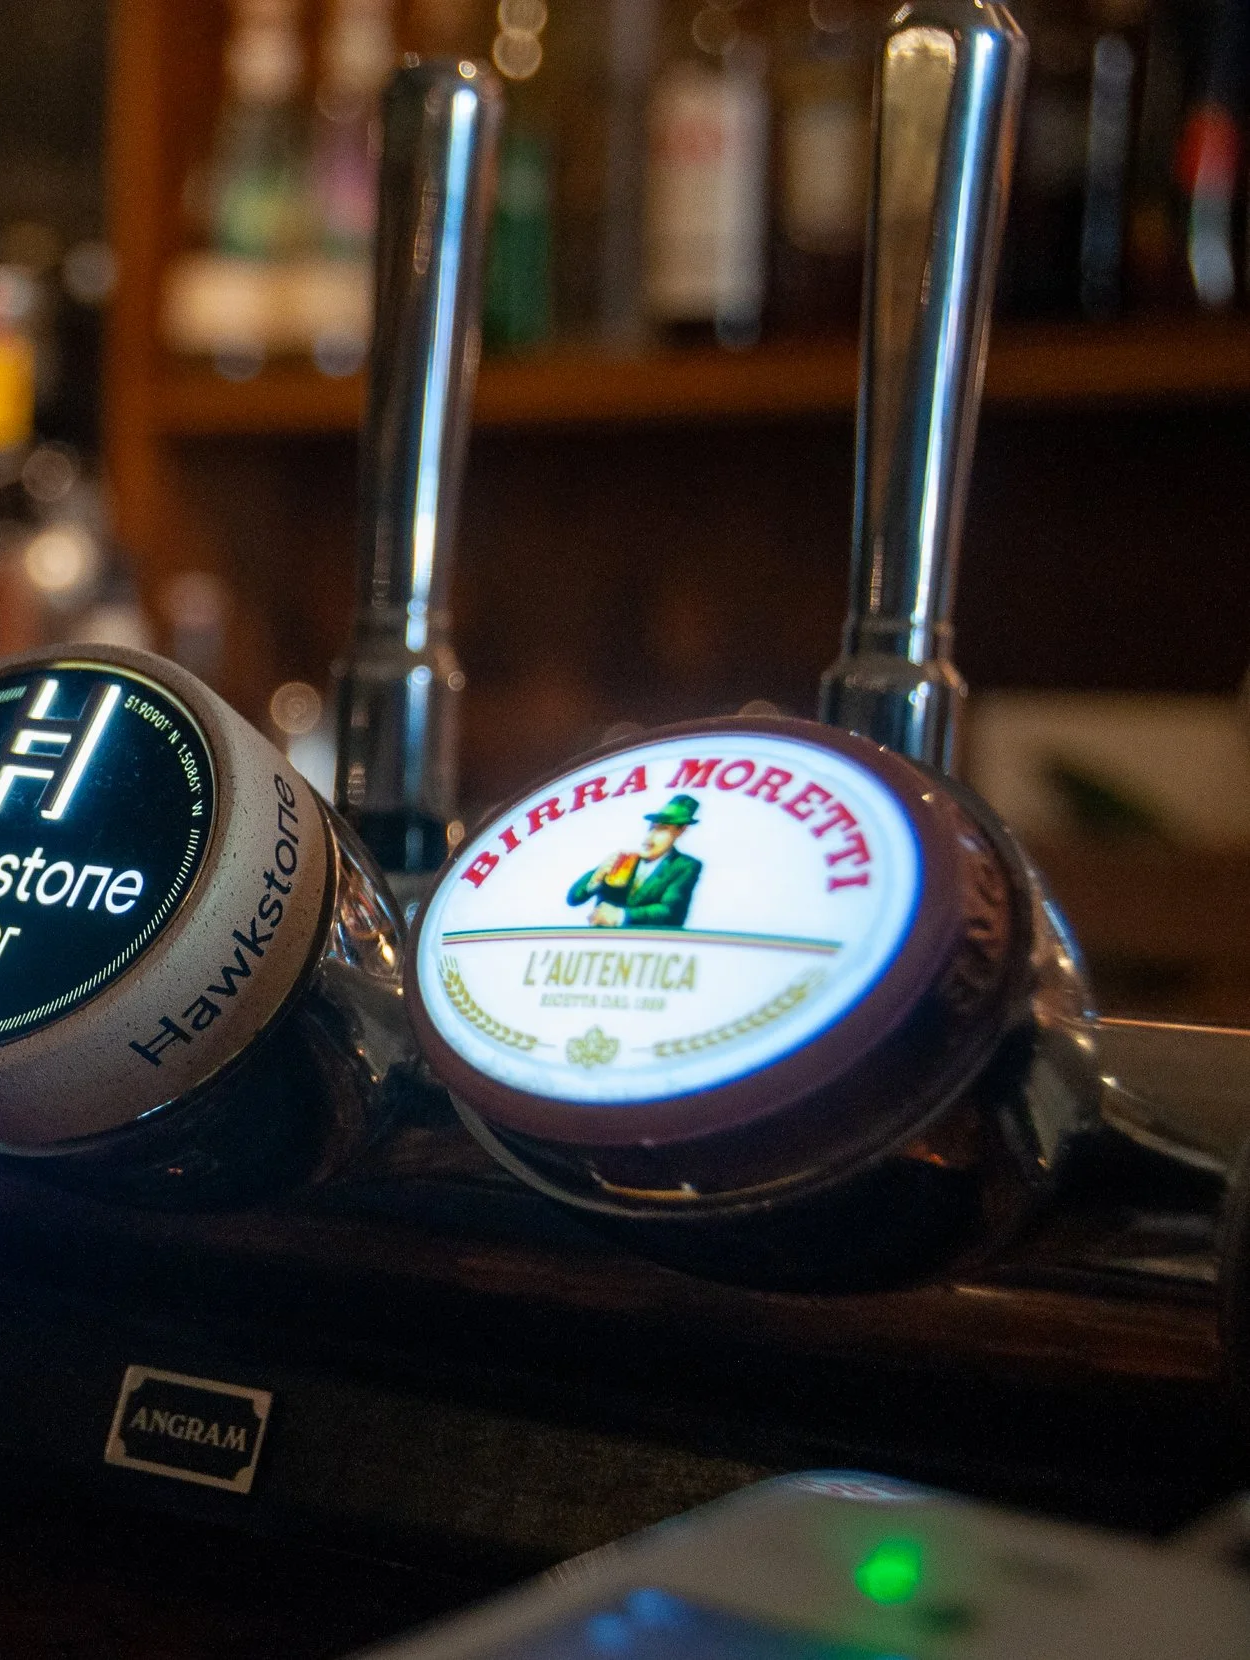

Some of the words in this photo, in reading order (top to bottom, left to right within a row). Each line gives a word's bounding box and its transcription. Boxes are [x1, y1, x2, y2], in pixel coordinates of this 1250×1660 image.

[167, 729, 182, 744] N
[191, 800, 204, 816] W
[460, 764, 648, 889] BIRRA
[664, 758, 872, 893] MORETTI
[128, 773, 300, 1068] Hawkstone
[523, 949, 699, 993] L'AUTENTICA
[129, 1405, 248, 1452] ANGRAM
